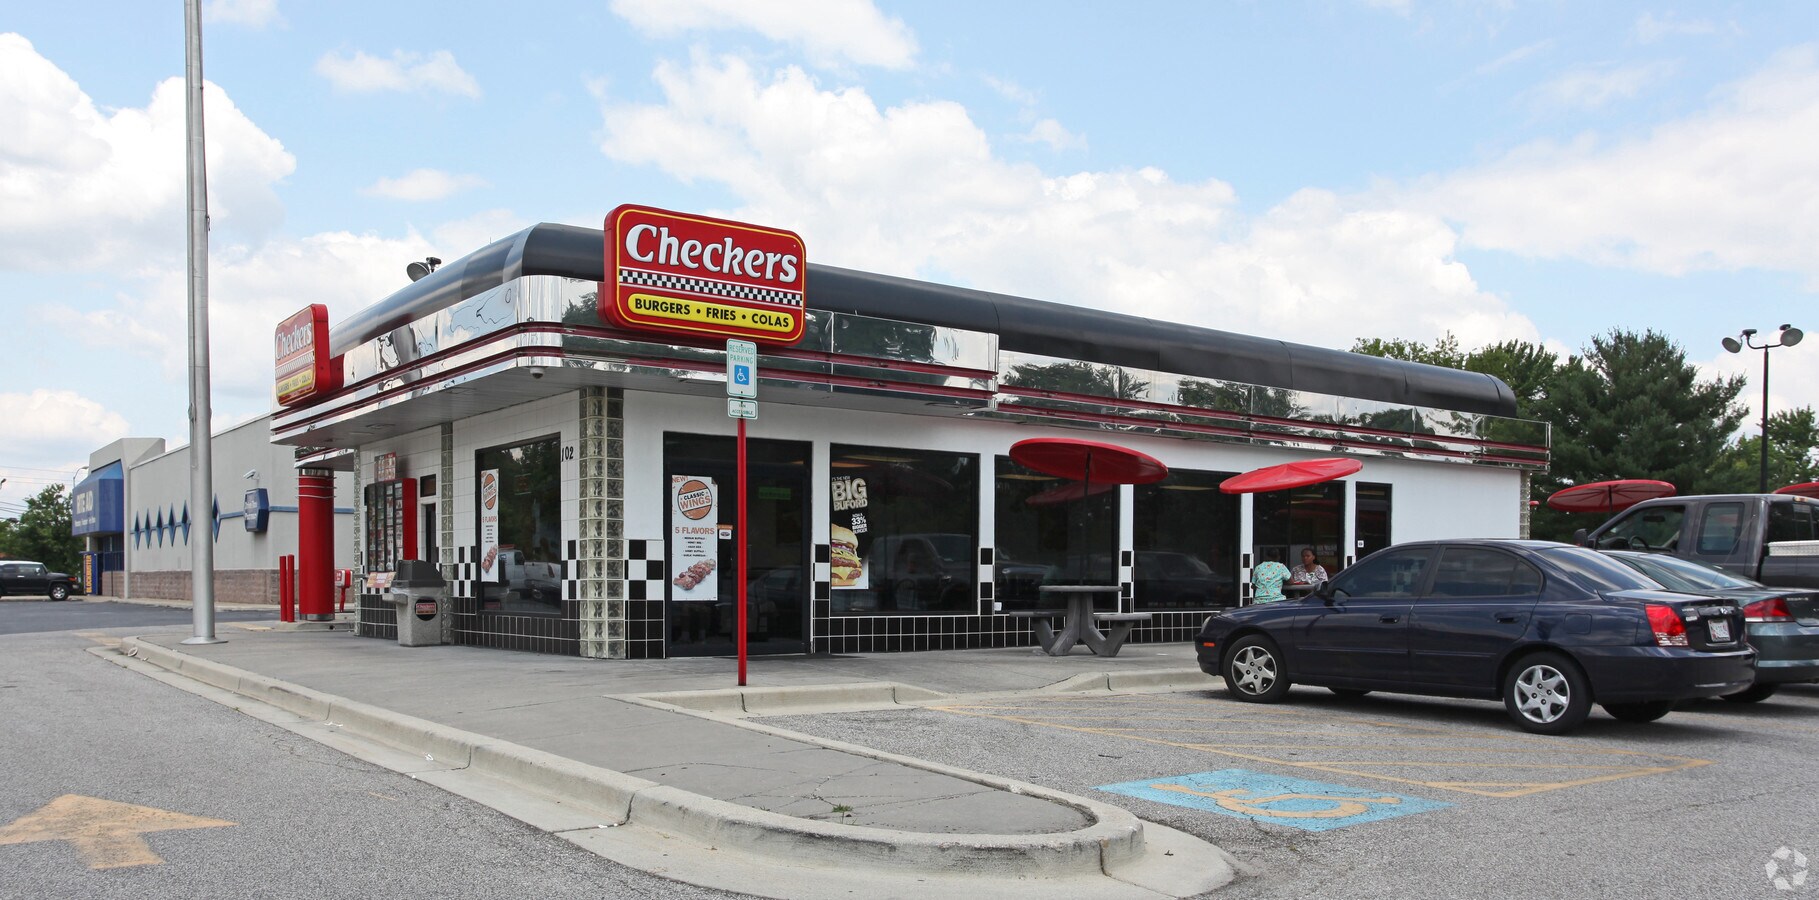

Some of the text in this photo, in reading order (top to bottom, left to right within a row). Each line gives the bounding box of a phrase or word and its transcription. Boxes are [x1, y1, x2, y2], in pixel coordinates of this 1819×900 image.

[625, 223, 798, 283] Checkers
[634, 298, 789, 328] BURGERS FRIES COLAS
[276, 322, 312, 359] Checkers
[728, 344, 754, 355] RESERVED
[730, 354, 753, 365] PARKING
[561, 445, 574, 462] 102
[832, 478, 867, 500] BIG
[684, 491, 705, 501] CLASSIC
[680, 496, 711, 510] WINGS
[833, 498, 868, 511] BUFORD
[851, 516, 867, 525] 33%
[674, 526, 680, 534] 5
[681, 526, 715, 535] FLAVORS
